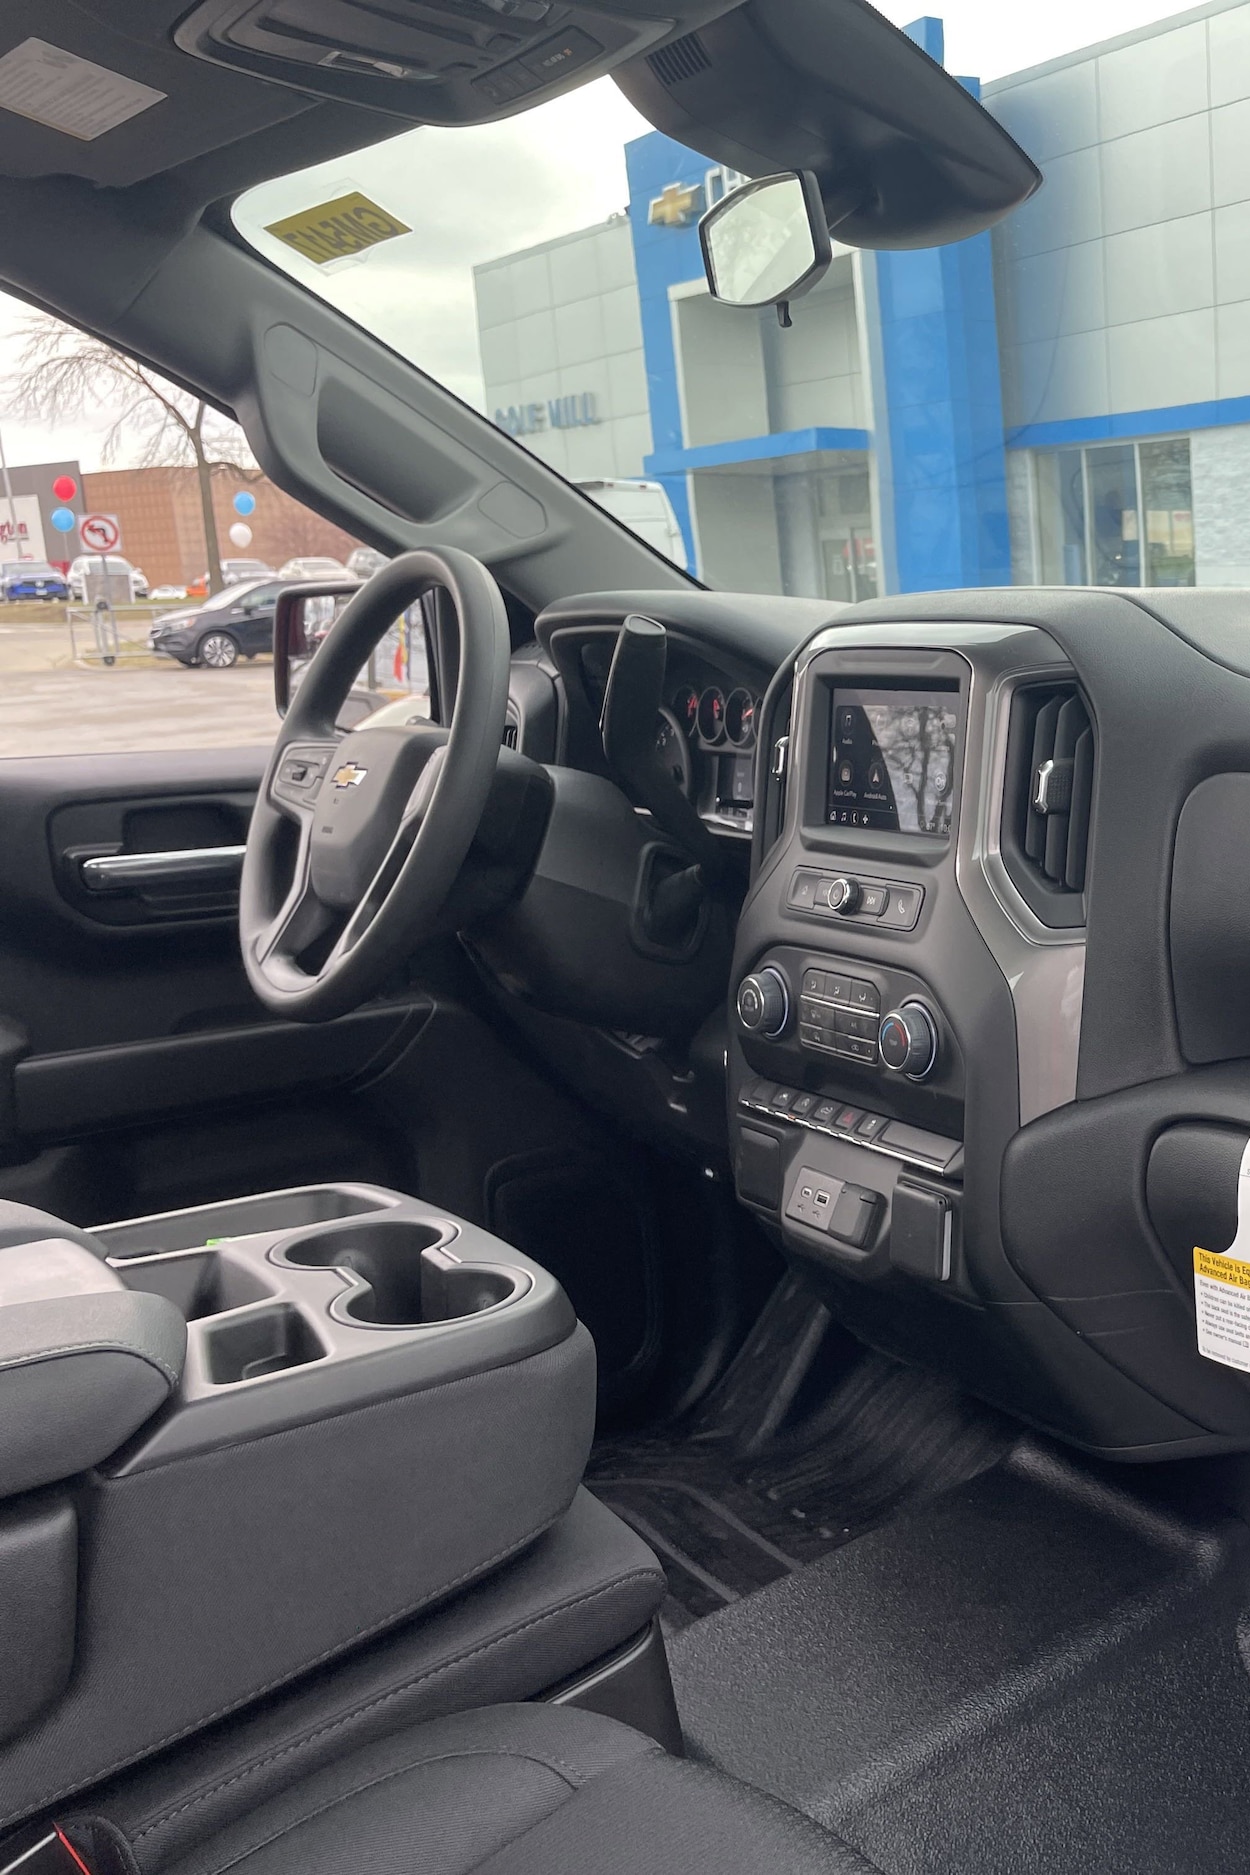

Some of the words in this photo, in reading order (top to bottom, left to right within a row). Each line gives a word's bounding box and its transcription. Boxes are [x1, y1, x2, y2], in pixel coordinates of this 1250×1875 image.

[1199, 1252, 1210, 1264] This
[1212, 1257, 1233, 1271] Vehicle
[1200, 1263, 1227, 1280] Advanced
[1229, 1273, 1238, 1282] Air
